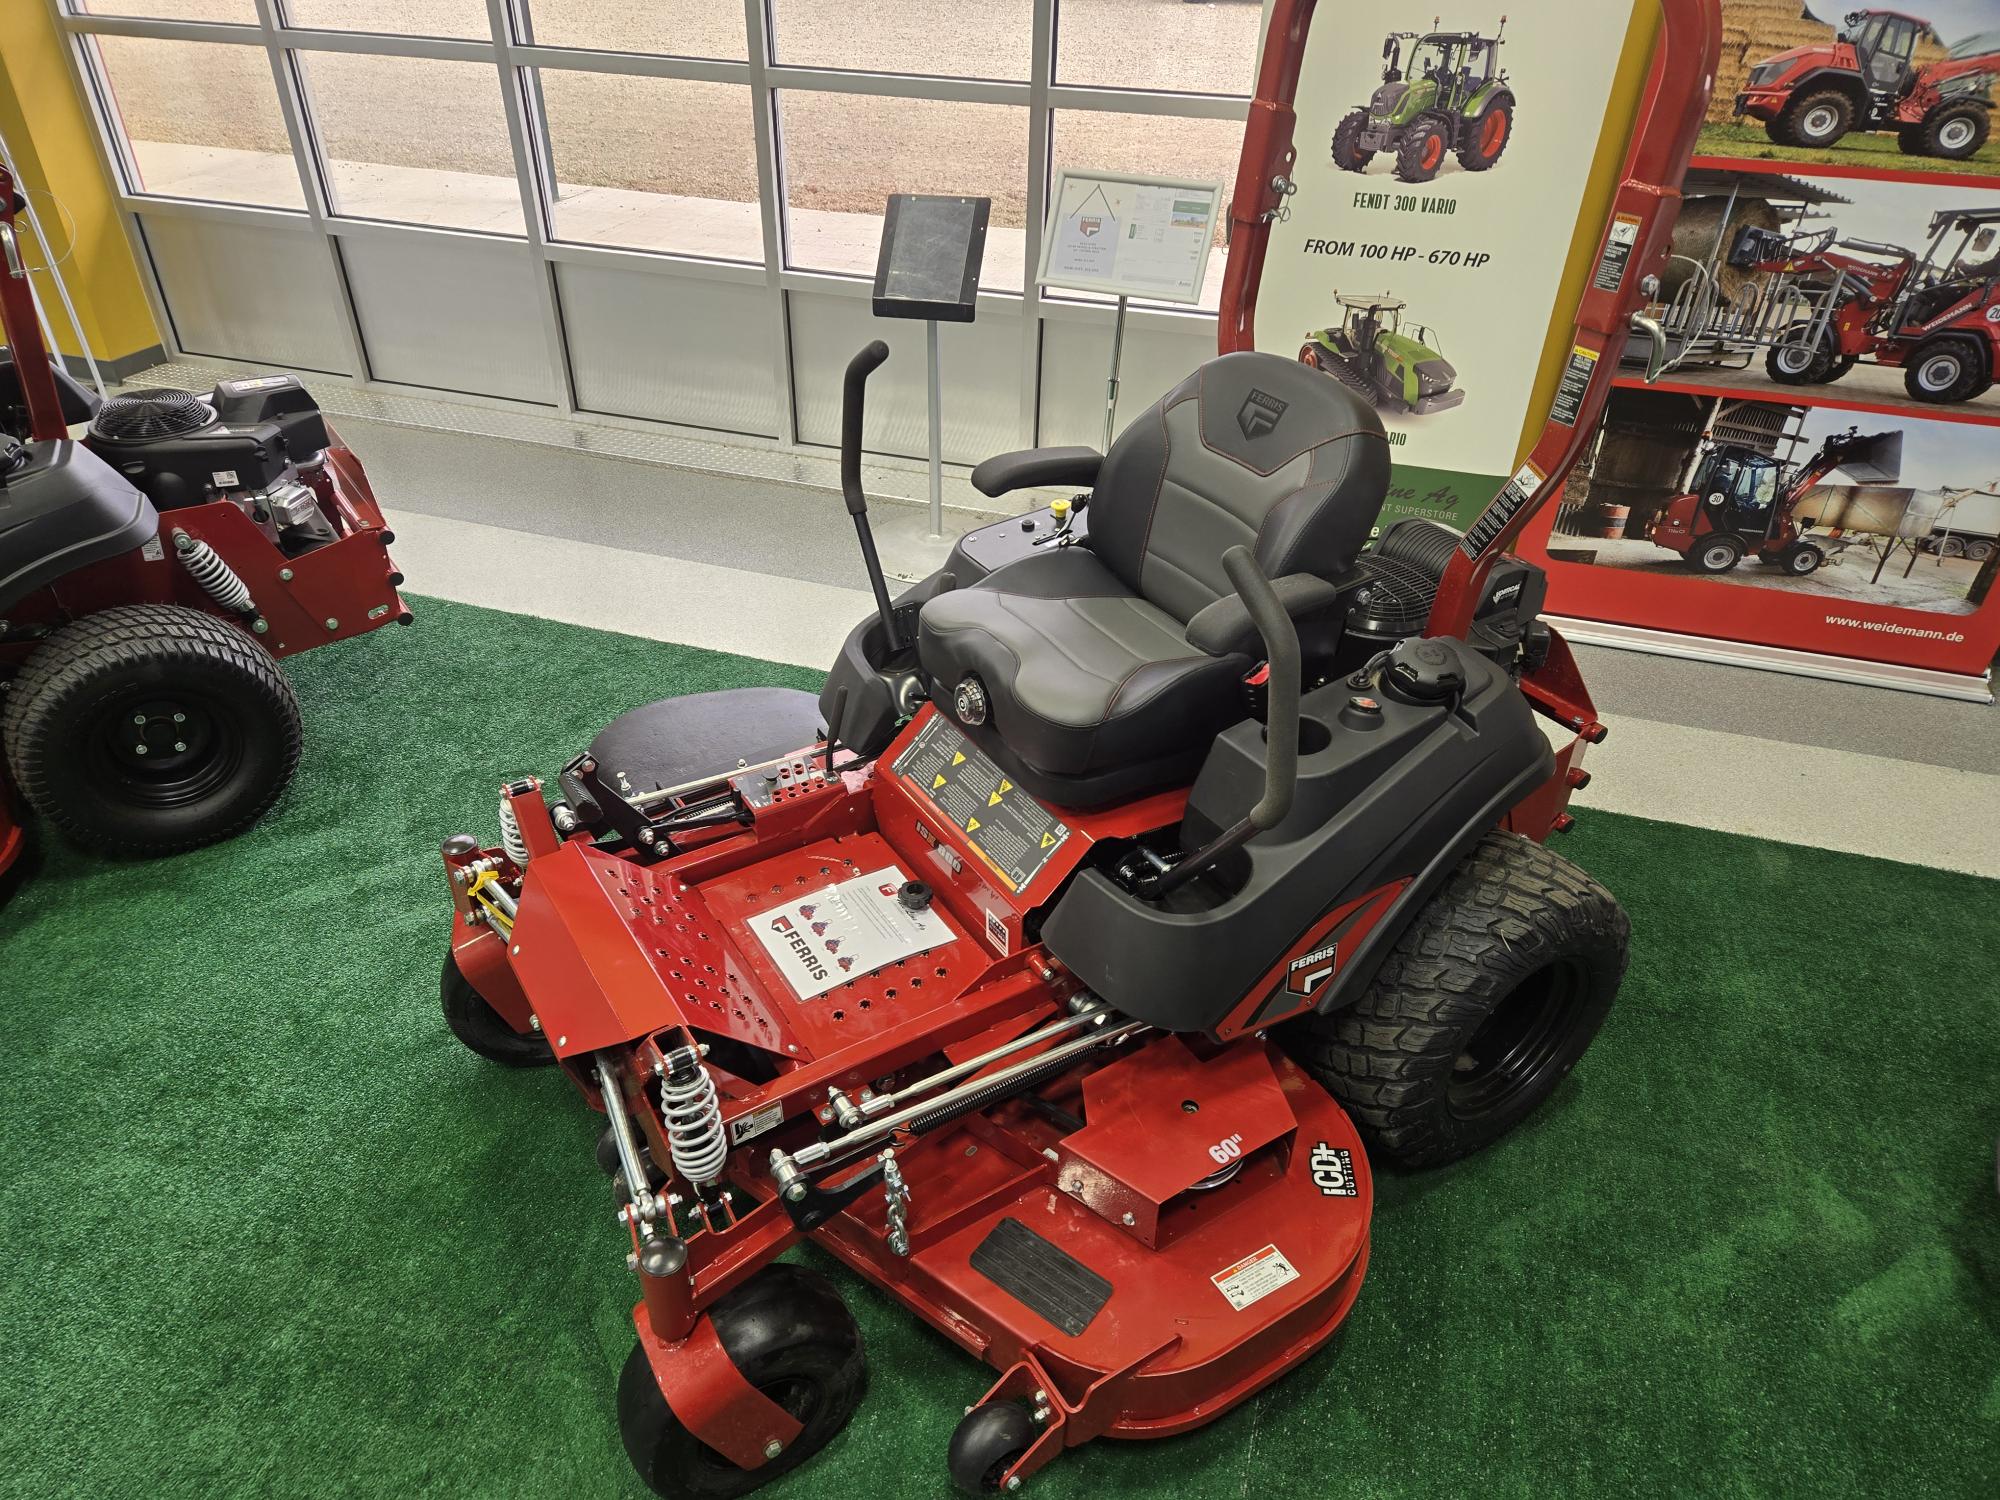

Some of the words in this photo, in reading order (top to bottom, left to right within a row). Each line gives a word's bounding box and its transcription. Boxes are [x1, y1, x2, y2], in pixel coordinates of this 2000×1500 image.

[1353, 192, 1390, 210] FENDT
[1394, 195, 1417, 212] 300
[1421, 197, 1457, 215] VARIO
[1303, 239, 1355, 257] FROM
[1360, 243, 1388, 259] 100
[1390, 246, 1417, 262] HP
[1428, 250, 1461, 266] 670
[1463, 252, 1491, 268] HP
[1921, 302, 1973, 332] WEIDEMANN
[1251, 391, 1285, 411] FERRIS
[1386, 483, 1416, 500] ine
[1420, 485, 1460, 511] Ag
[1394, 504, 1459, 521] SUPERSTORE
[1825, 615, 1965, 643] www.weidemann.de
[783, 931, 829, 981] FERRIS
[1291, 946, 1335, 972] FERRIS
[1339, 1150, 1357, 1196] CUTTING
[1236, 1256, 1258, 1271] DANGER
